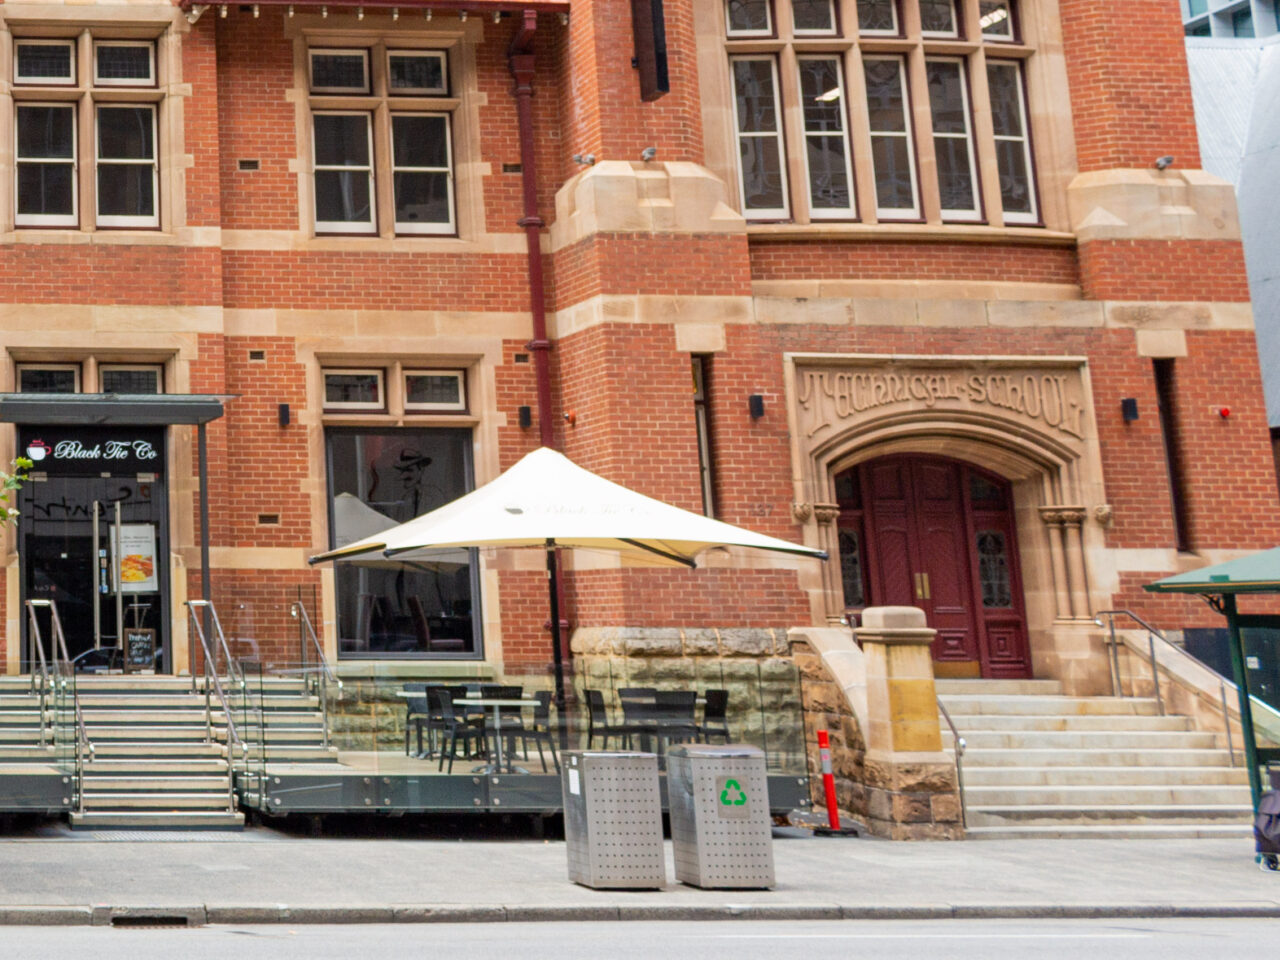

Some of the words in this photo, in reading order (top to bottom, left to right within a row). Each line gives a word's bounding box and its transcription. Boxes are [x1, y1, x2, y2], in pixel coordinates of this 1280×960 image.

[53, 440, 101, 459] Black
[102, 440, 131, 459] Tie
[132, 440, 158, 460] Co
